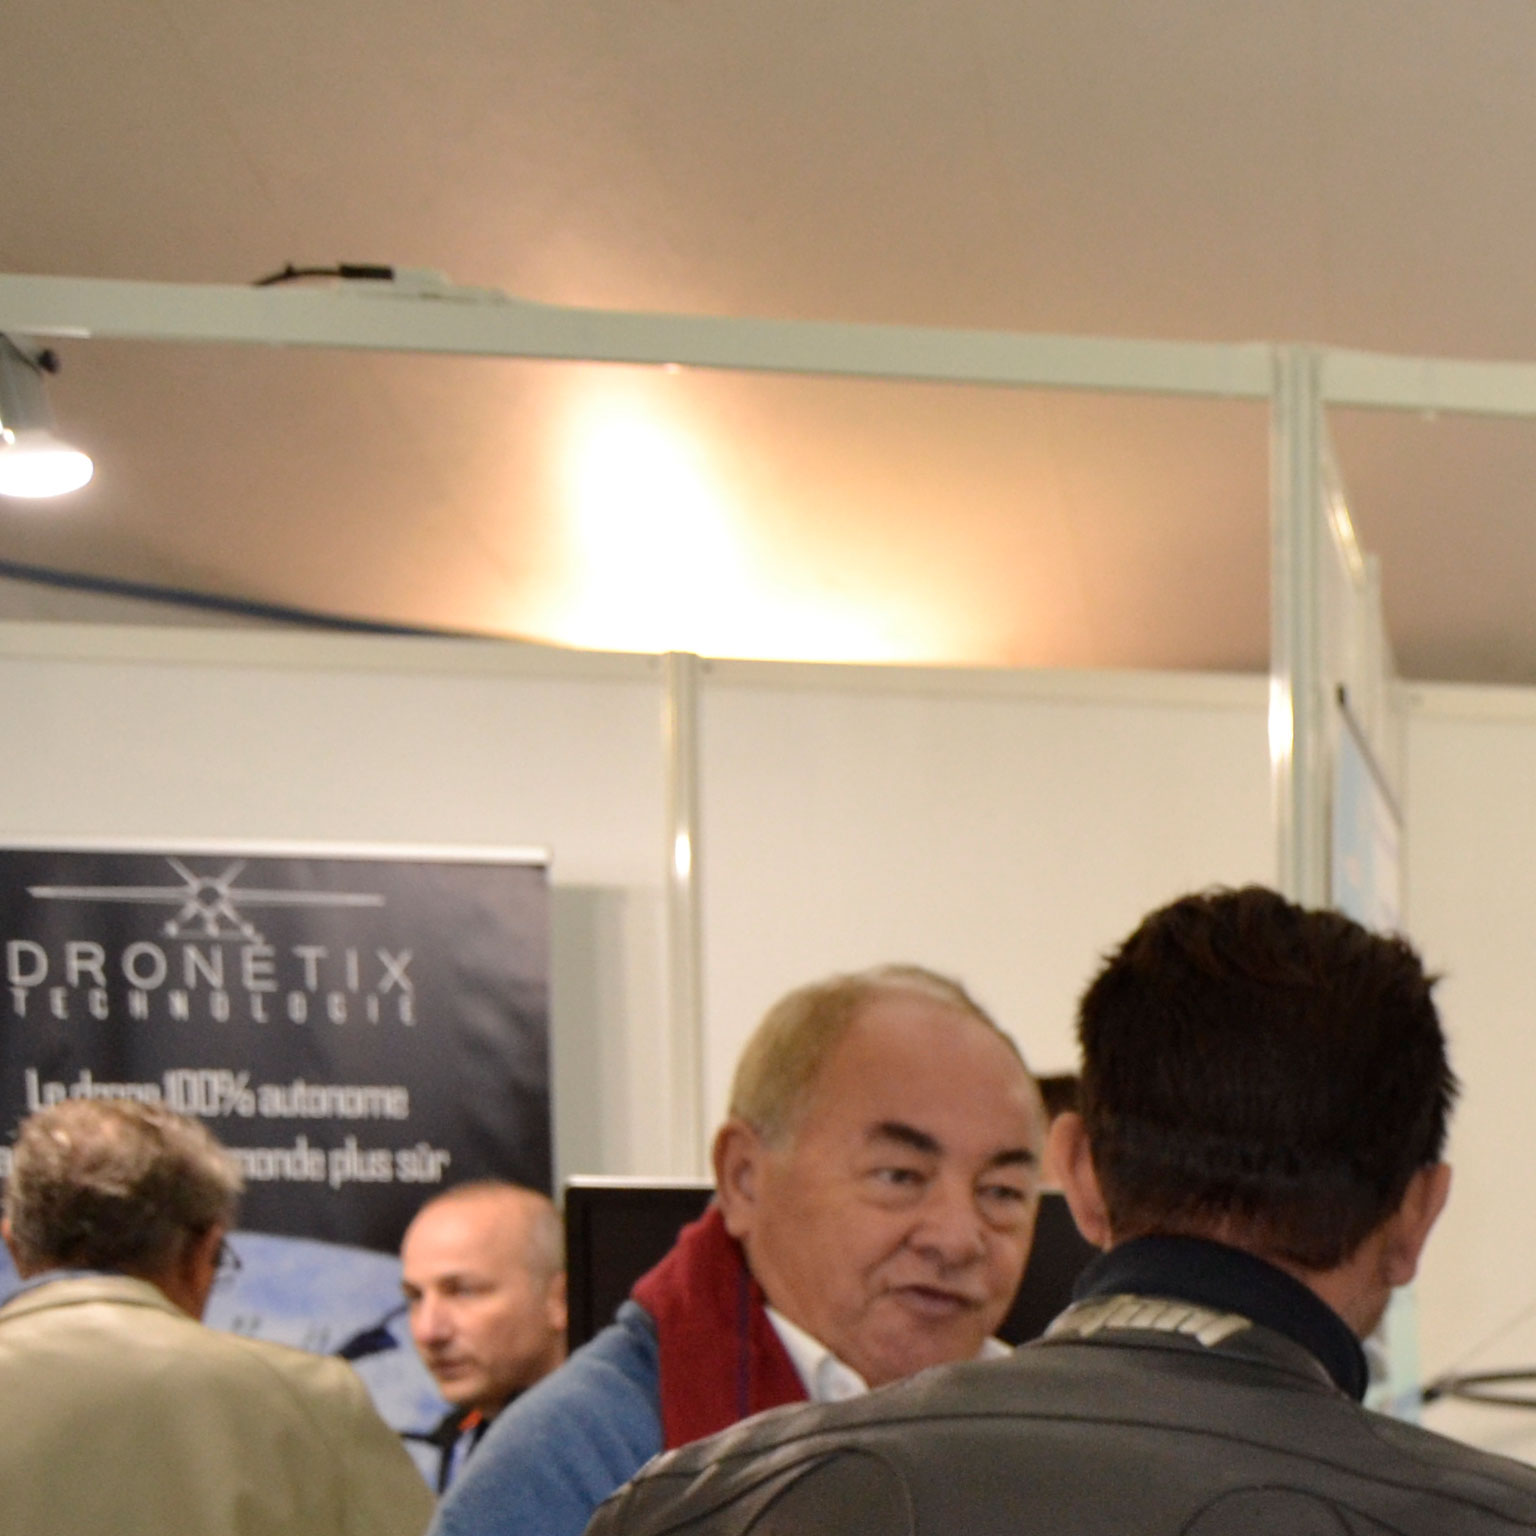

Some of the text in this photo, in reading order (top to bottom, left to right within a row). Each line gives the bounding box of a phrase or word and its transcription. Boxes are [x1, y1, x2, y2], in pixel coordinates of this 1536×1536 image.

[7, 940, 413, 993] DRONETIX
[163, 1068, 256, 1118] 100%
[257, 1078, 410, 1120] autonome
[329, 1134, 393, 1189] plus
[395, 1141, 451, 1183] sûr
